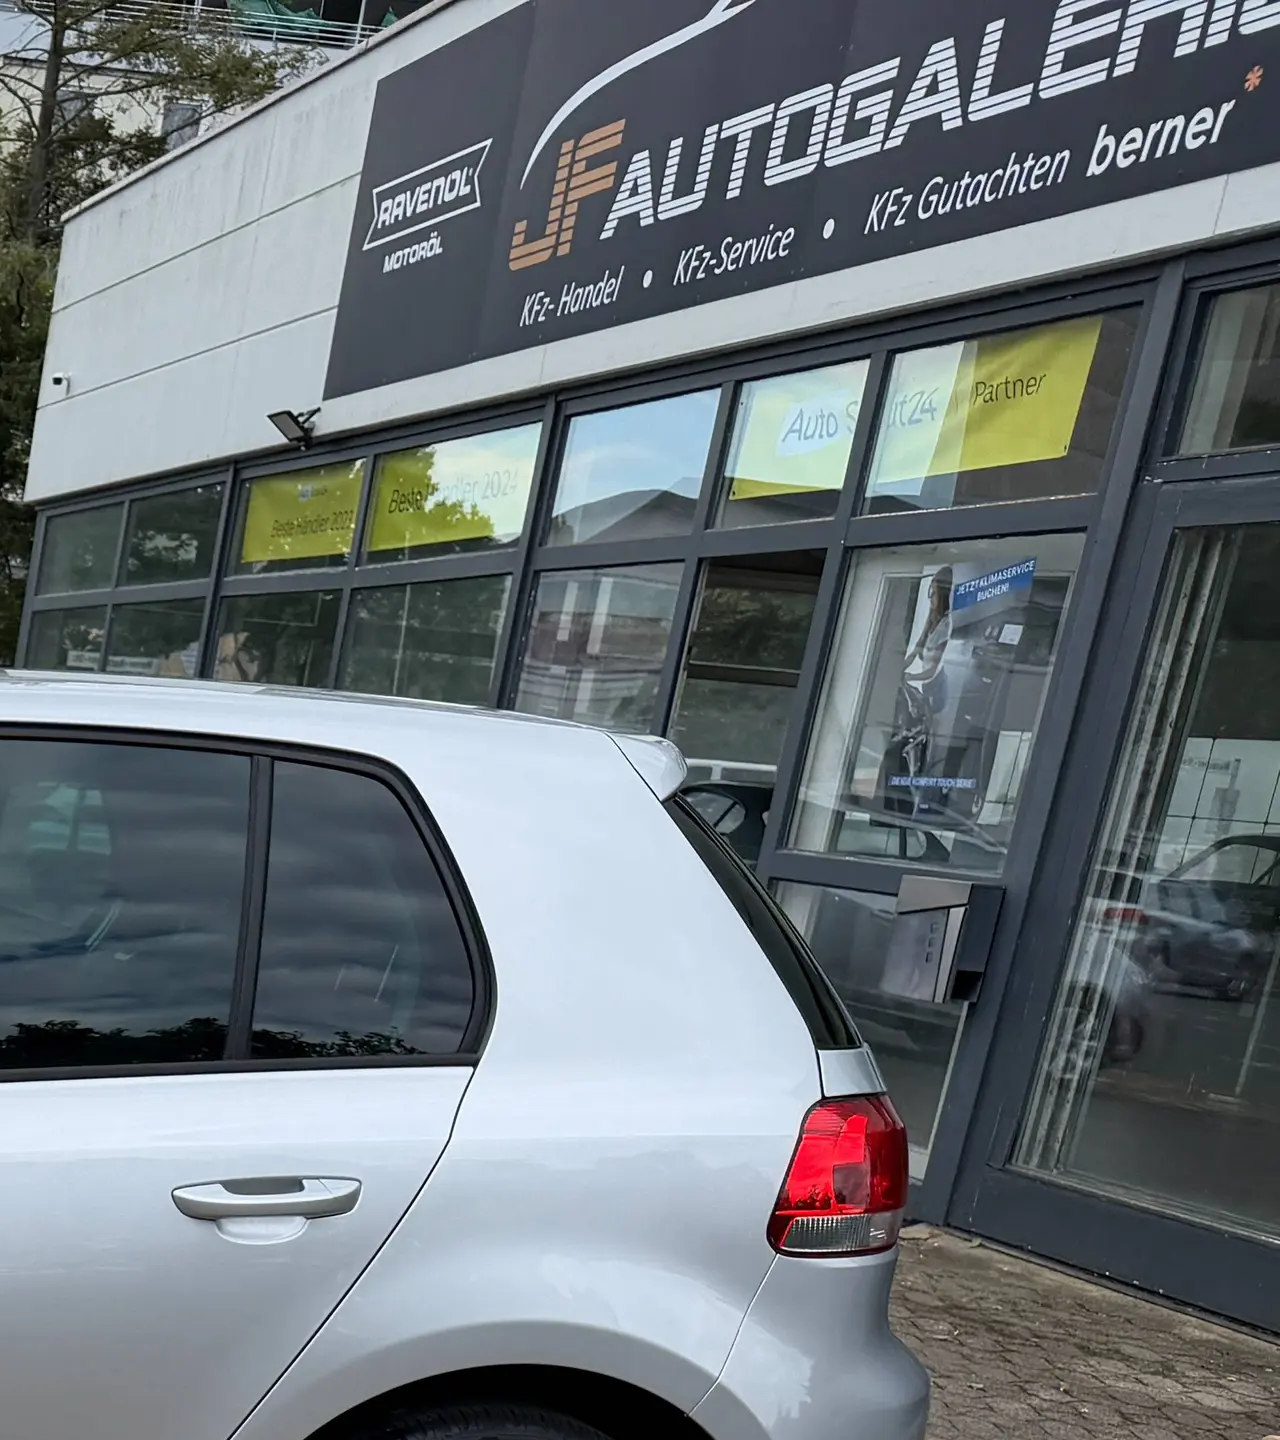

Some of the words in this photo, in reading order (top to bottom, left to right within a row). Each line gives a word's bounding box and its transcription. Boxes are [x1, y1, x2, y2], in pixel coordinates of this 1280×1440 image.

[598, 0, 1280, 240] AUTOGALERI
[1086, 99, 1237, 178] berner
[376, 166, 472, 229] RAVENOL
[863, 186, 914, 235] KFz
[917, 148, 1071, 220] Gutachten
[382, 231, 443, 273] MOTORÖL
[673, 223, 795, 286] KFz-Service
[556, 266, 625, 317] Handel
[781, 408, 839, 443] Auto
[972, 372, 1047, 406] Partner
[387, 489, 422, 514] Beste
[956, 581, 978, 595] JETZT
[978, 560, 1035, 587] KLIMASERVICE
[976, 582, 1010, 602] BUCHEN!
